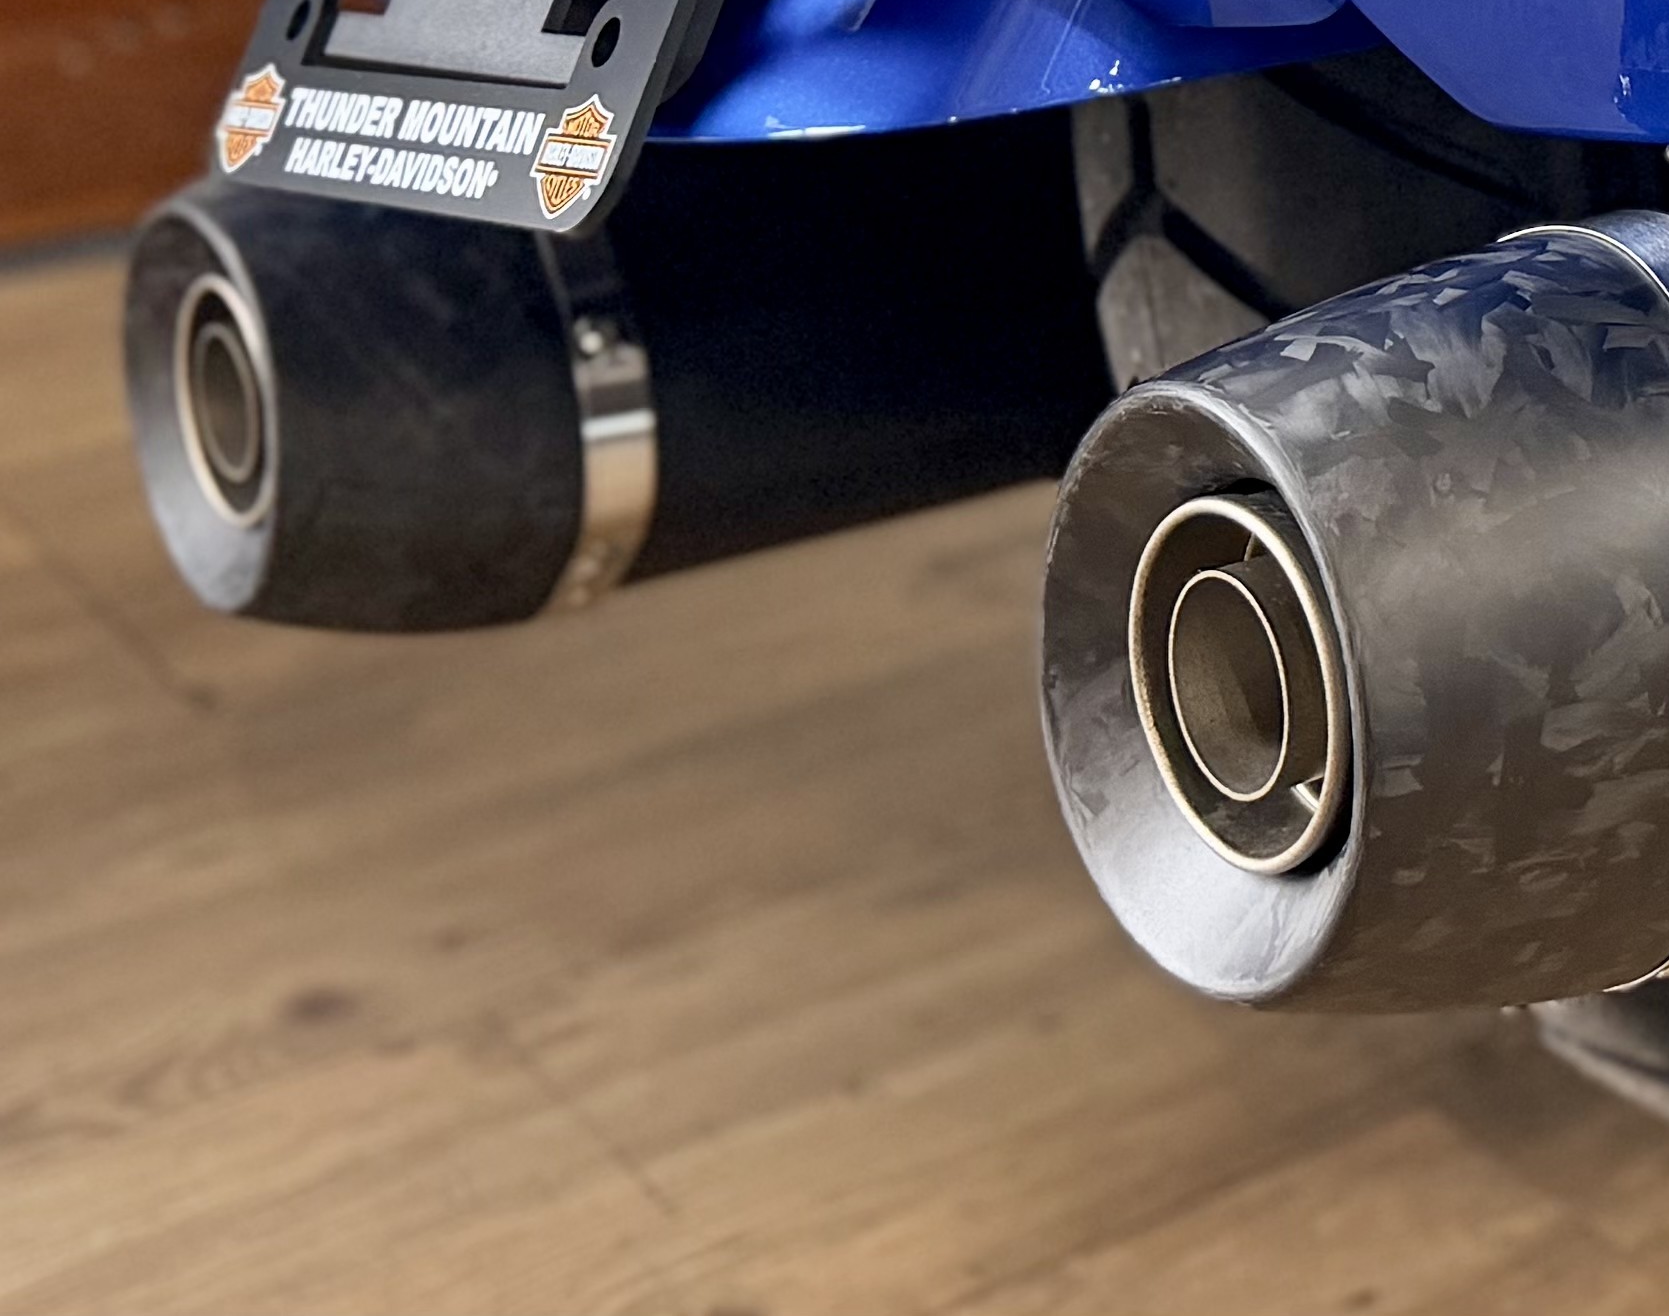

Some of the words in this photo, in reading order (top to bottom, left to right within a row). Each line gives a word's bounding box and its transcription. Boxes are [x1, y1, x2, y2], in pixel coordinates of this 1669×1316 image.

[284, 87, 404, 139] THUNDER
[397, 99, 547, 156] MOUNTAIN
[284, 136, 499, 200] HARLEY-DAVIDSON
